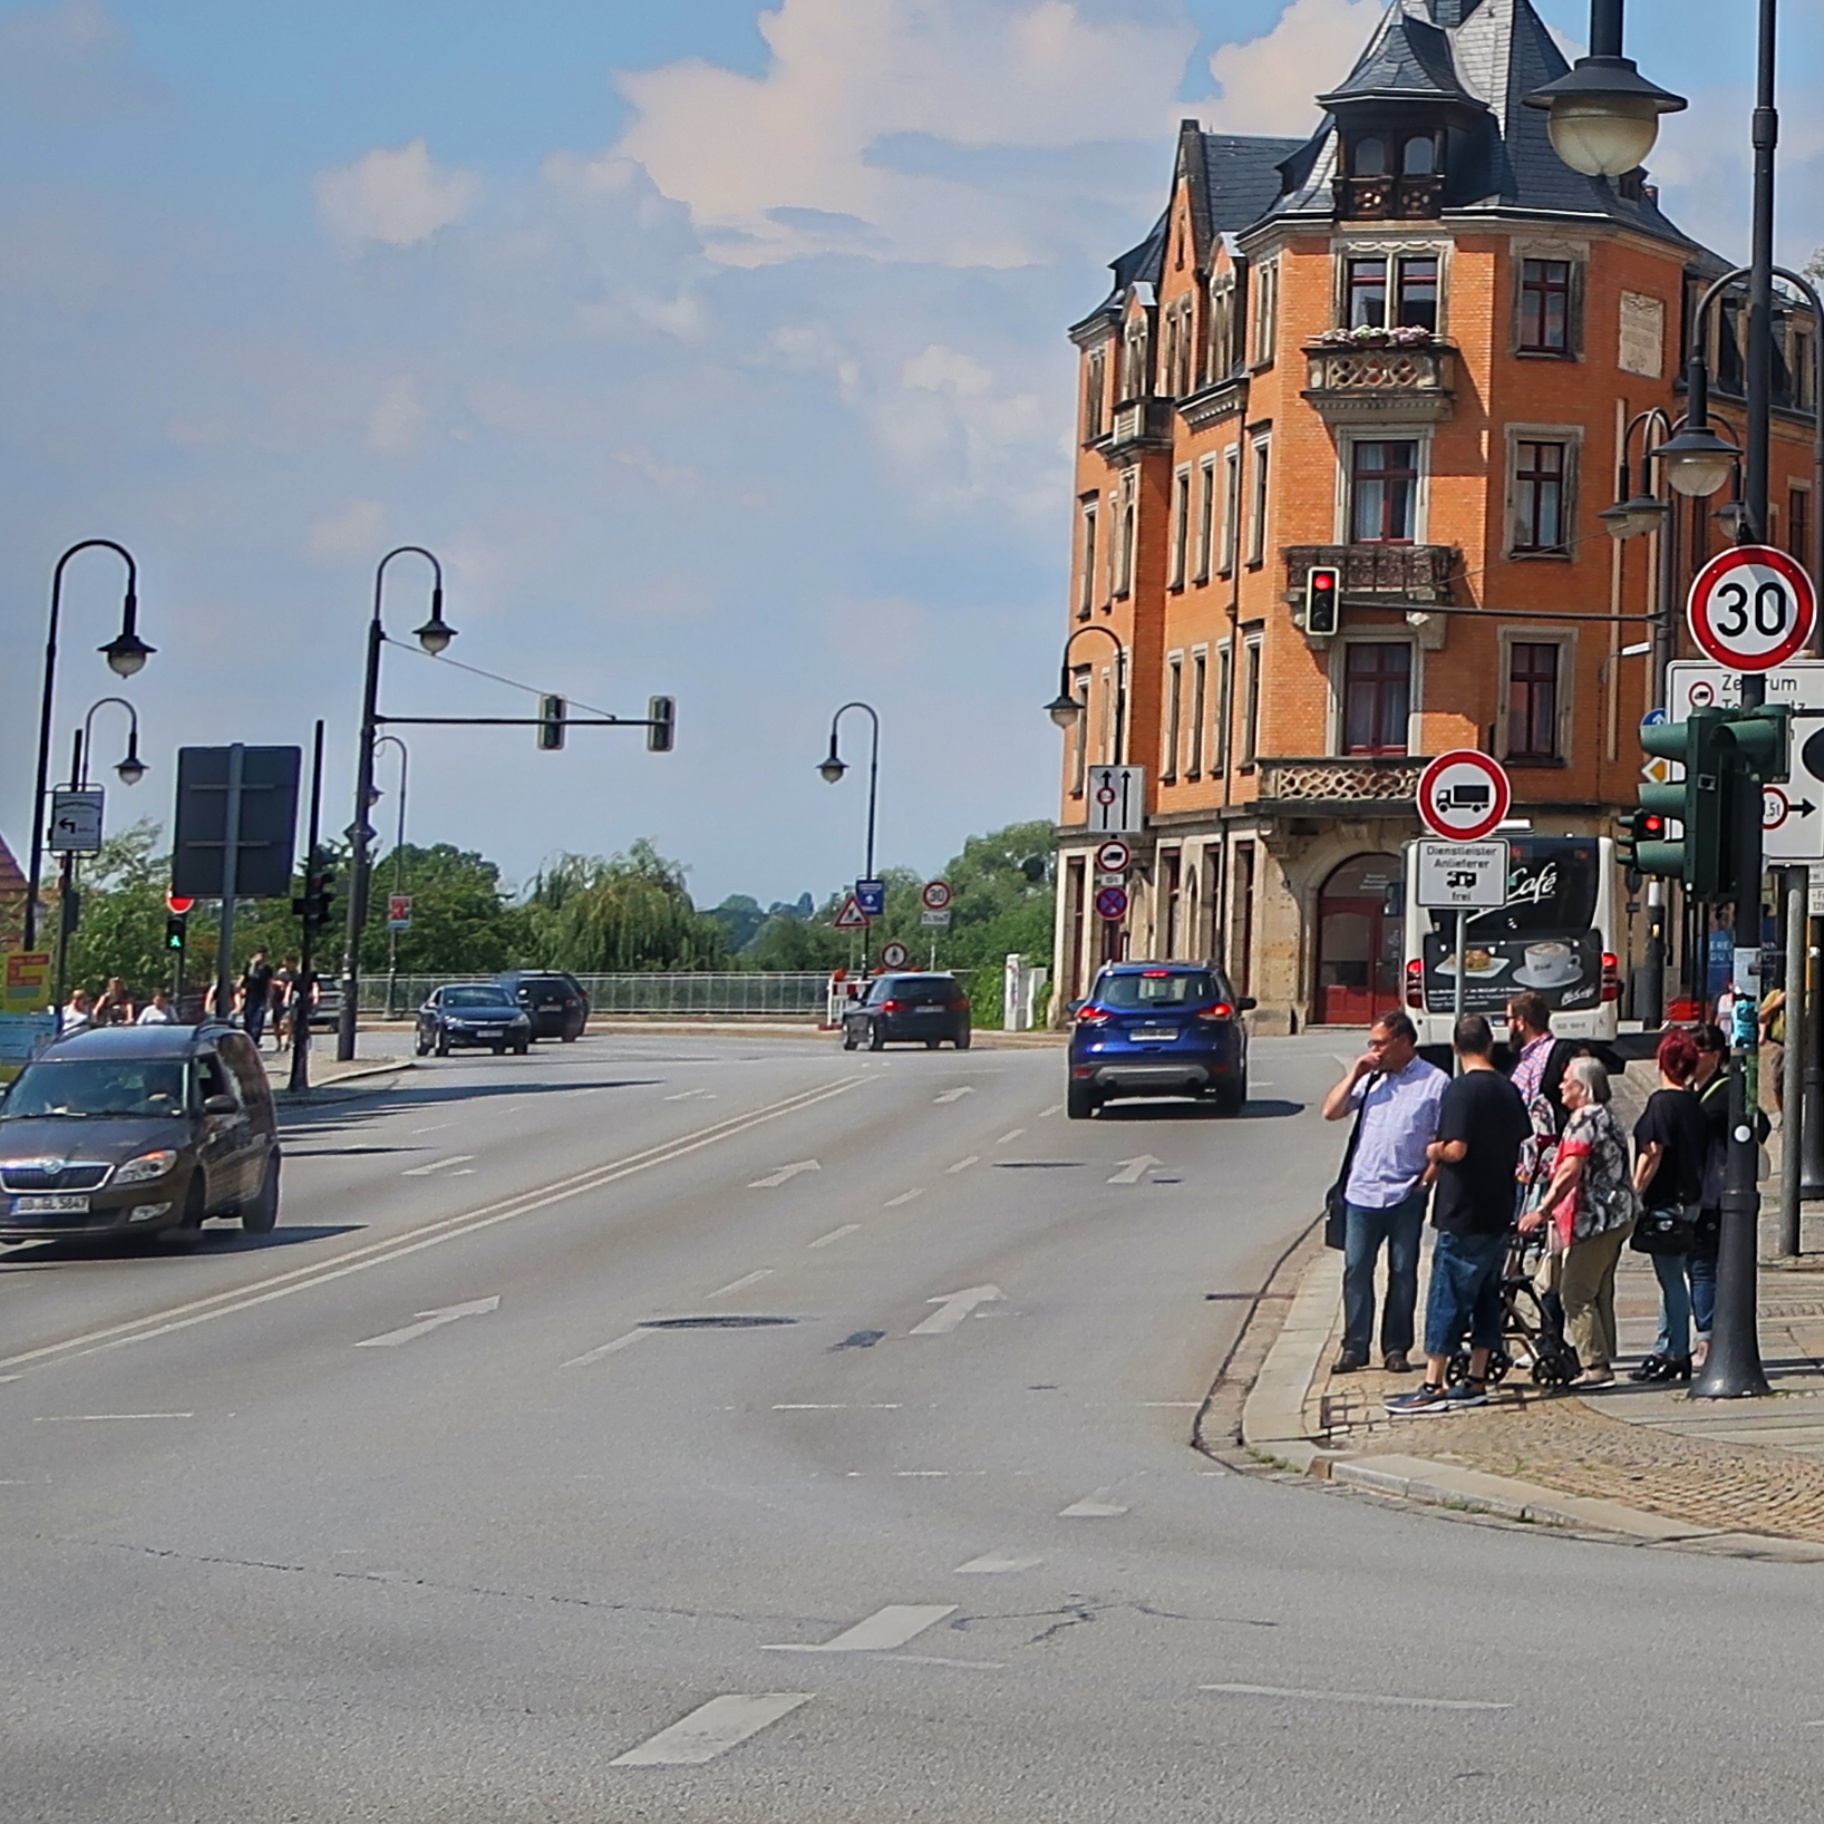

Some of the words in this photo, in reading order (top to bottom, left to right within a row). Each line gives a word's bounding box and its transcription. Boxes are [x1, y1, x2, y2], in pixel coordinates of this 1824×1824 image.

[1717, 582, 1787, 637] 30
[1427, 845, 1497, 856] Dienstleister
[1434, 858, 1490, 868] Anlieferer
[930, 889, 945, 902] 30
[1452, 891, 1471, 902] frei
